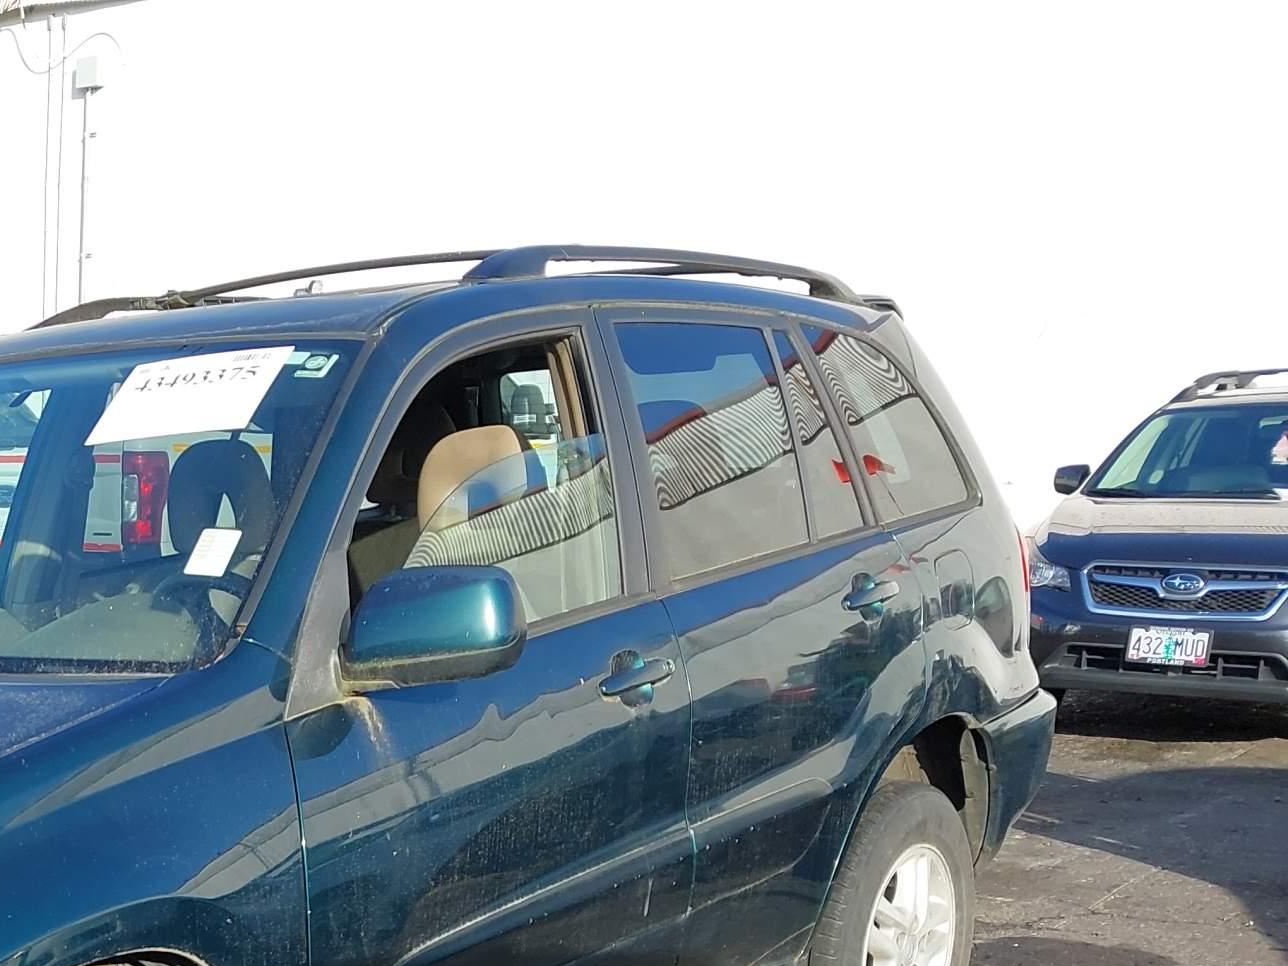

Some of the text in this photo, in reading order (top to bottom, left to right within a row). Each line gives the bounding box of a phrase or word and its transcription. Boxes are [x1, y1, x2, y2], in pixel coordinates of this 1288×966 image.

[134, 365, 261, 392] 43493375
[1132, 635, 1206, 658] 432 MUD
[1146, 658, 1185, 666] PORTLAND
